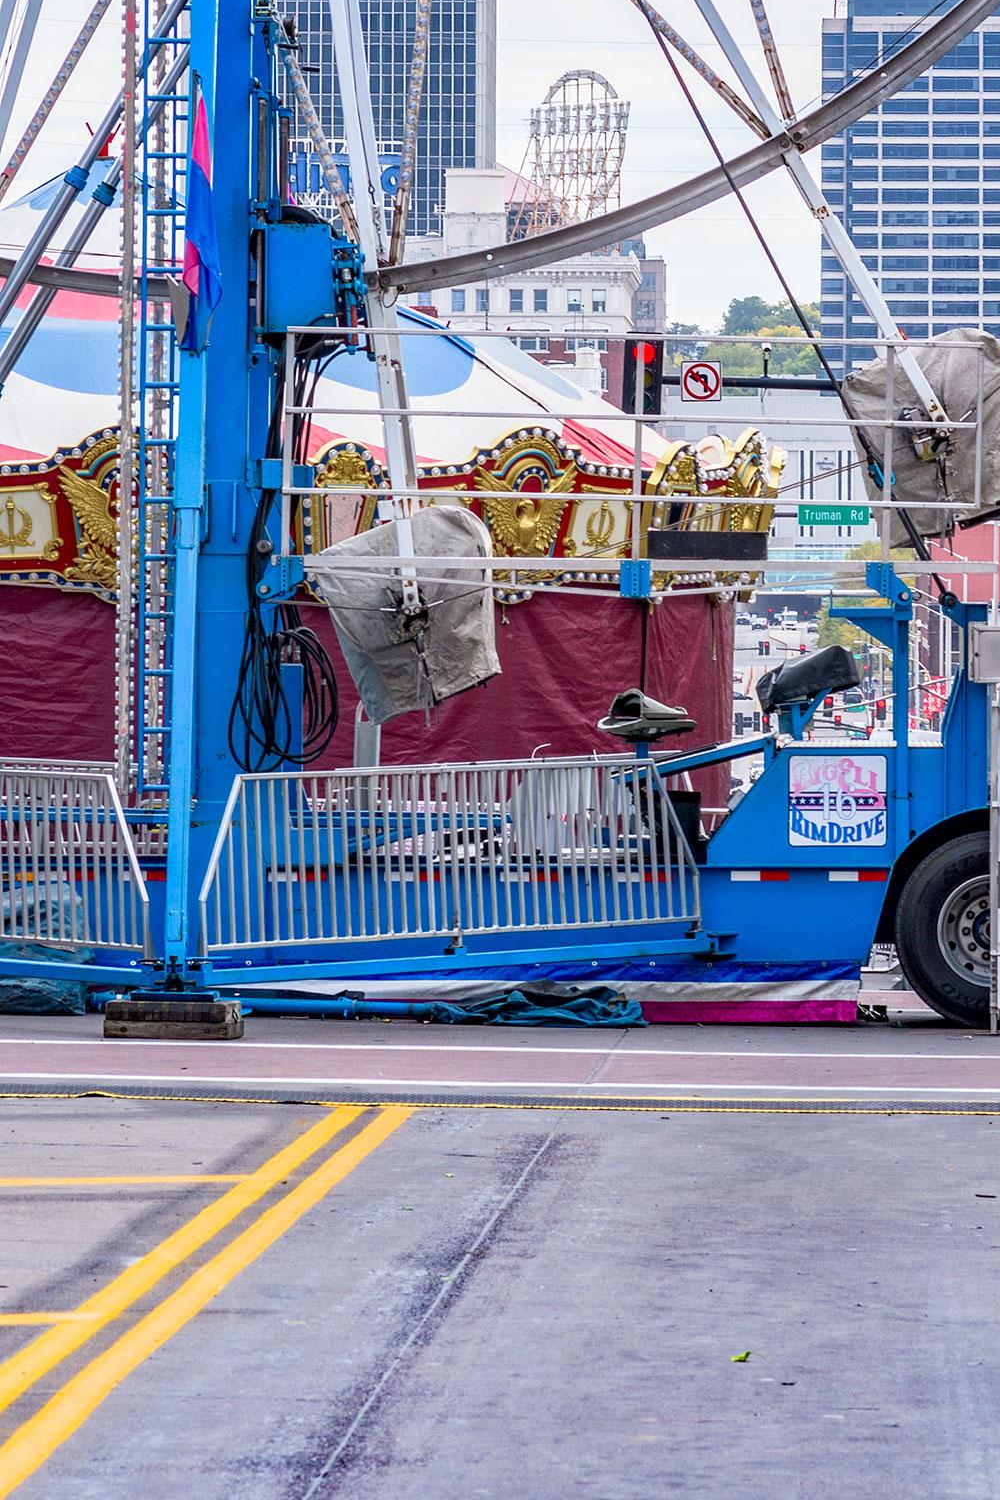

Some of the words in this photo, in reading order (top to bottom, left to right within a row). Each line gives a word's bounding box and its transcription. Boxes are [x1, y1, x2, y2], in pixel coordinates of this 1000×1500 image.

[804, 509, 842, 521] Truman
[850, 509, 864, 521] Rd
[819, 782, 857, 820] 16
